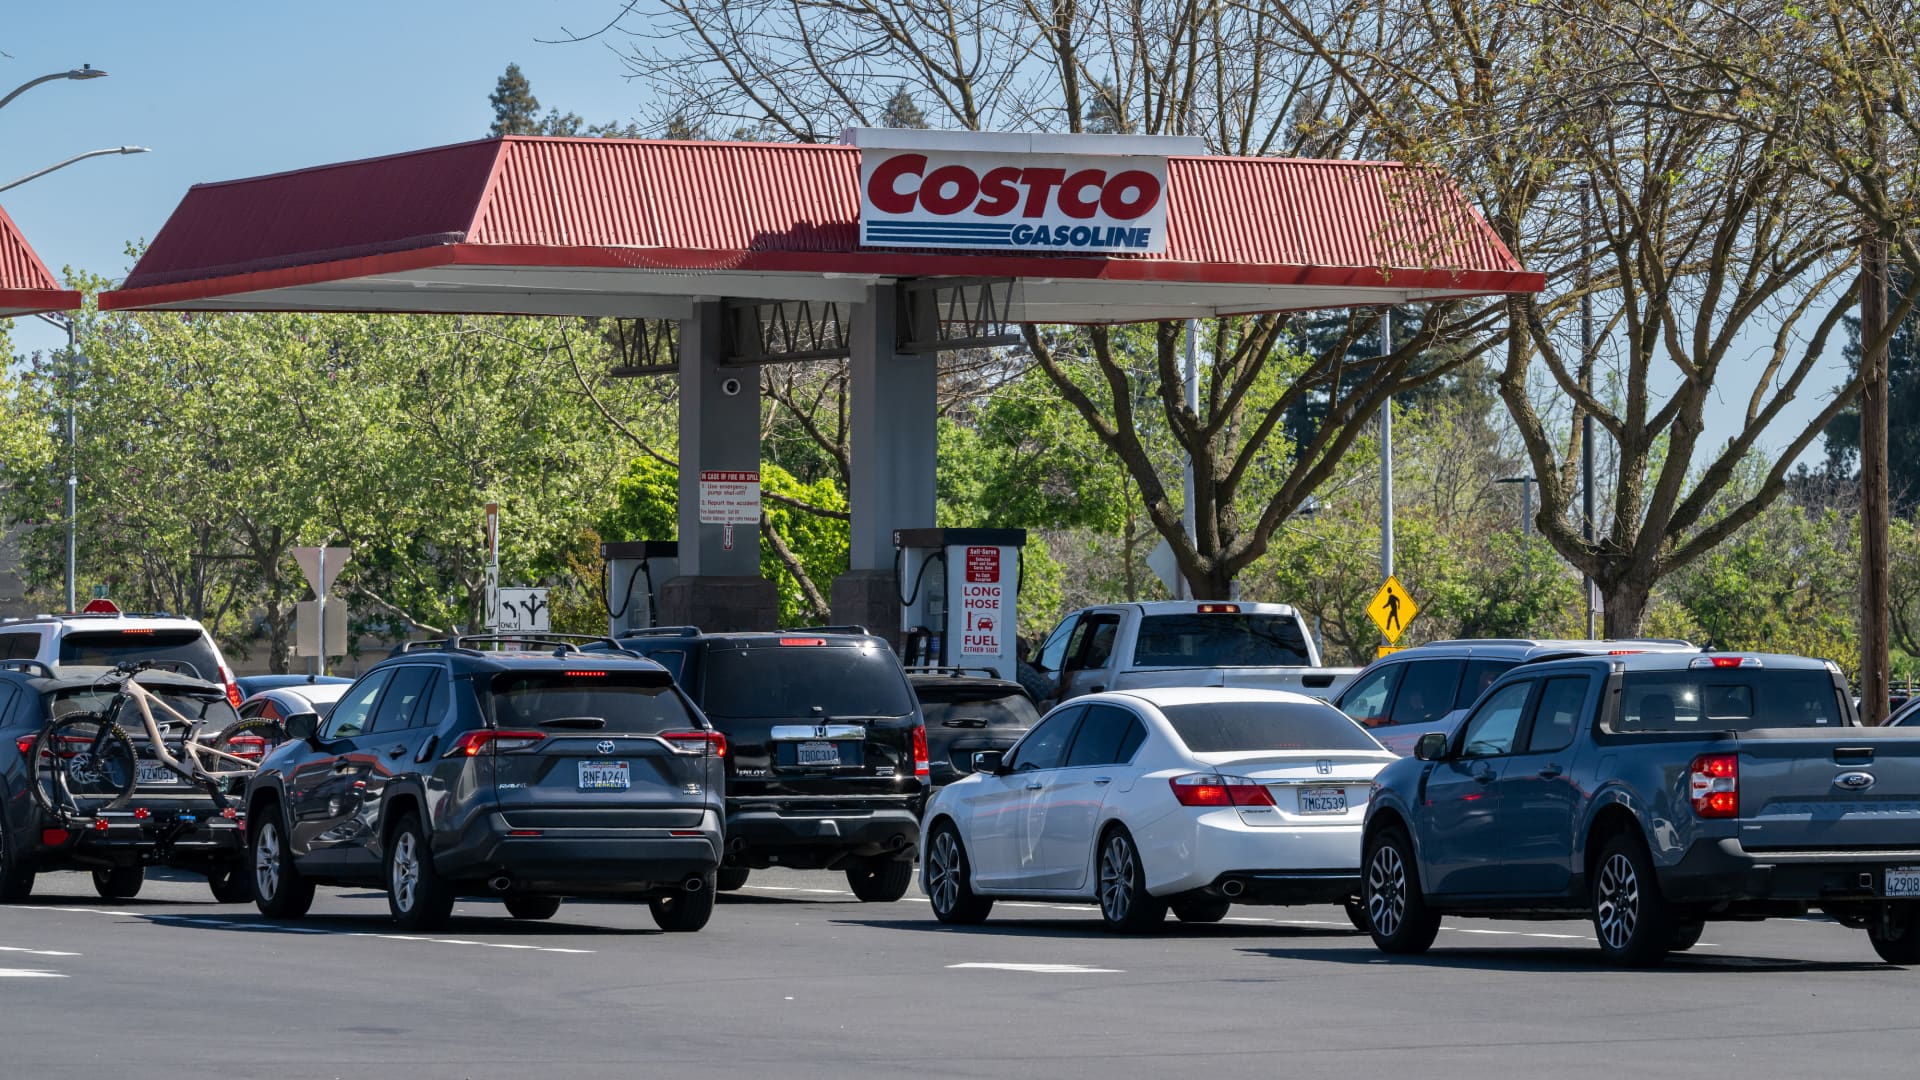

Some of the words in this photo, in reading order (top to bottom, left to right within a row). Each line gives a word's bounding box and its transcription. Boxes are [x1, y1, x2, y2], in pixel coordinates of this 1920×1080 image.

[867, 153, 1161, 220] COSTCO
[1011, 224, 1152, 248] GASOLINE
[964, 586, 1001, 597] LONG
[964, 598, 999, 609] HOSE
[500, 621, 518, 629] ONLY
[964, 635, 999, 646] FUEL
[1302, 797, 1345, 810] 7MGZ539
